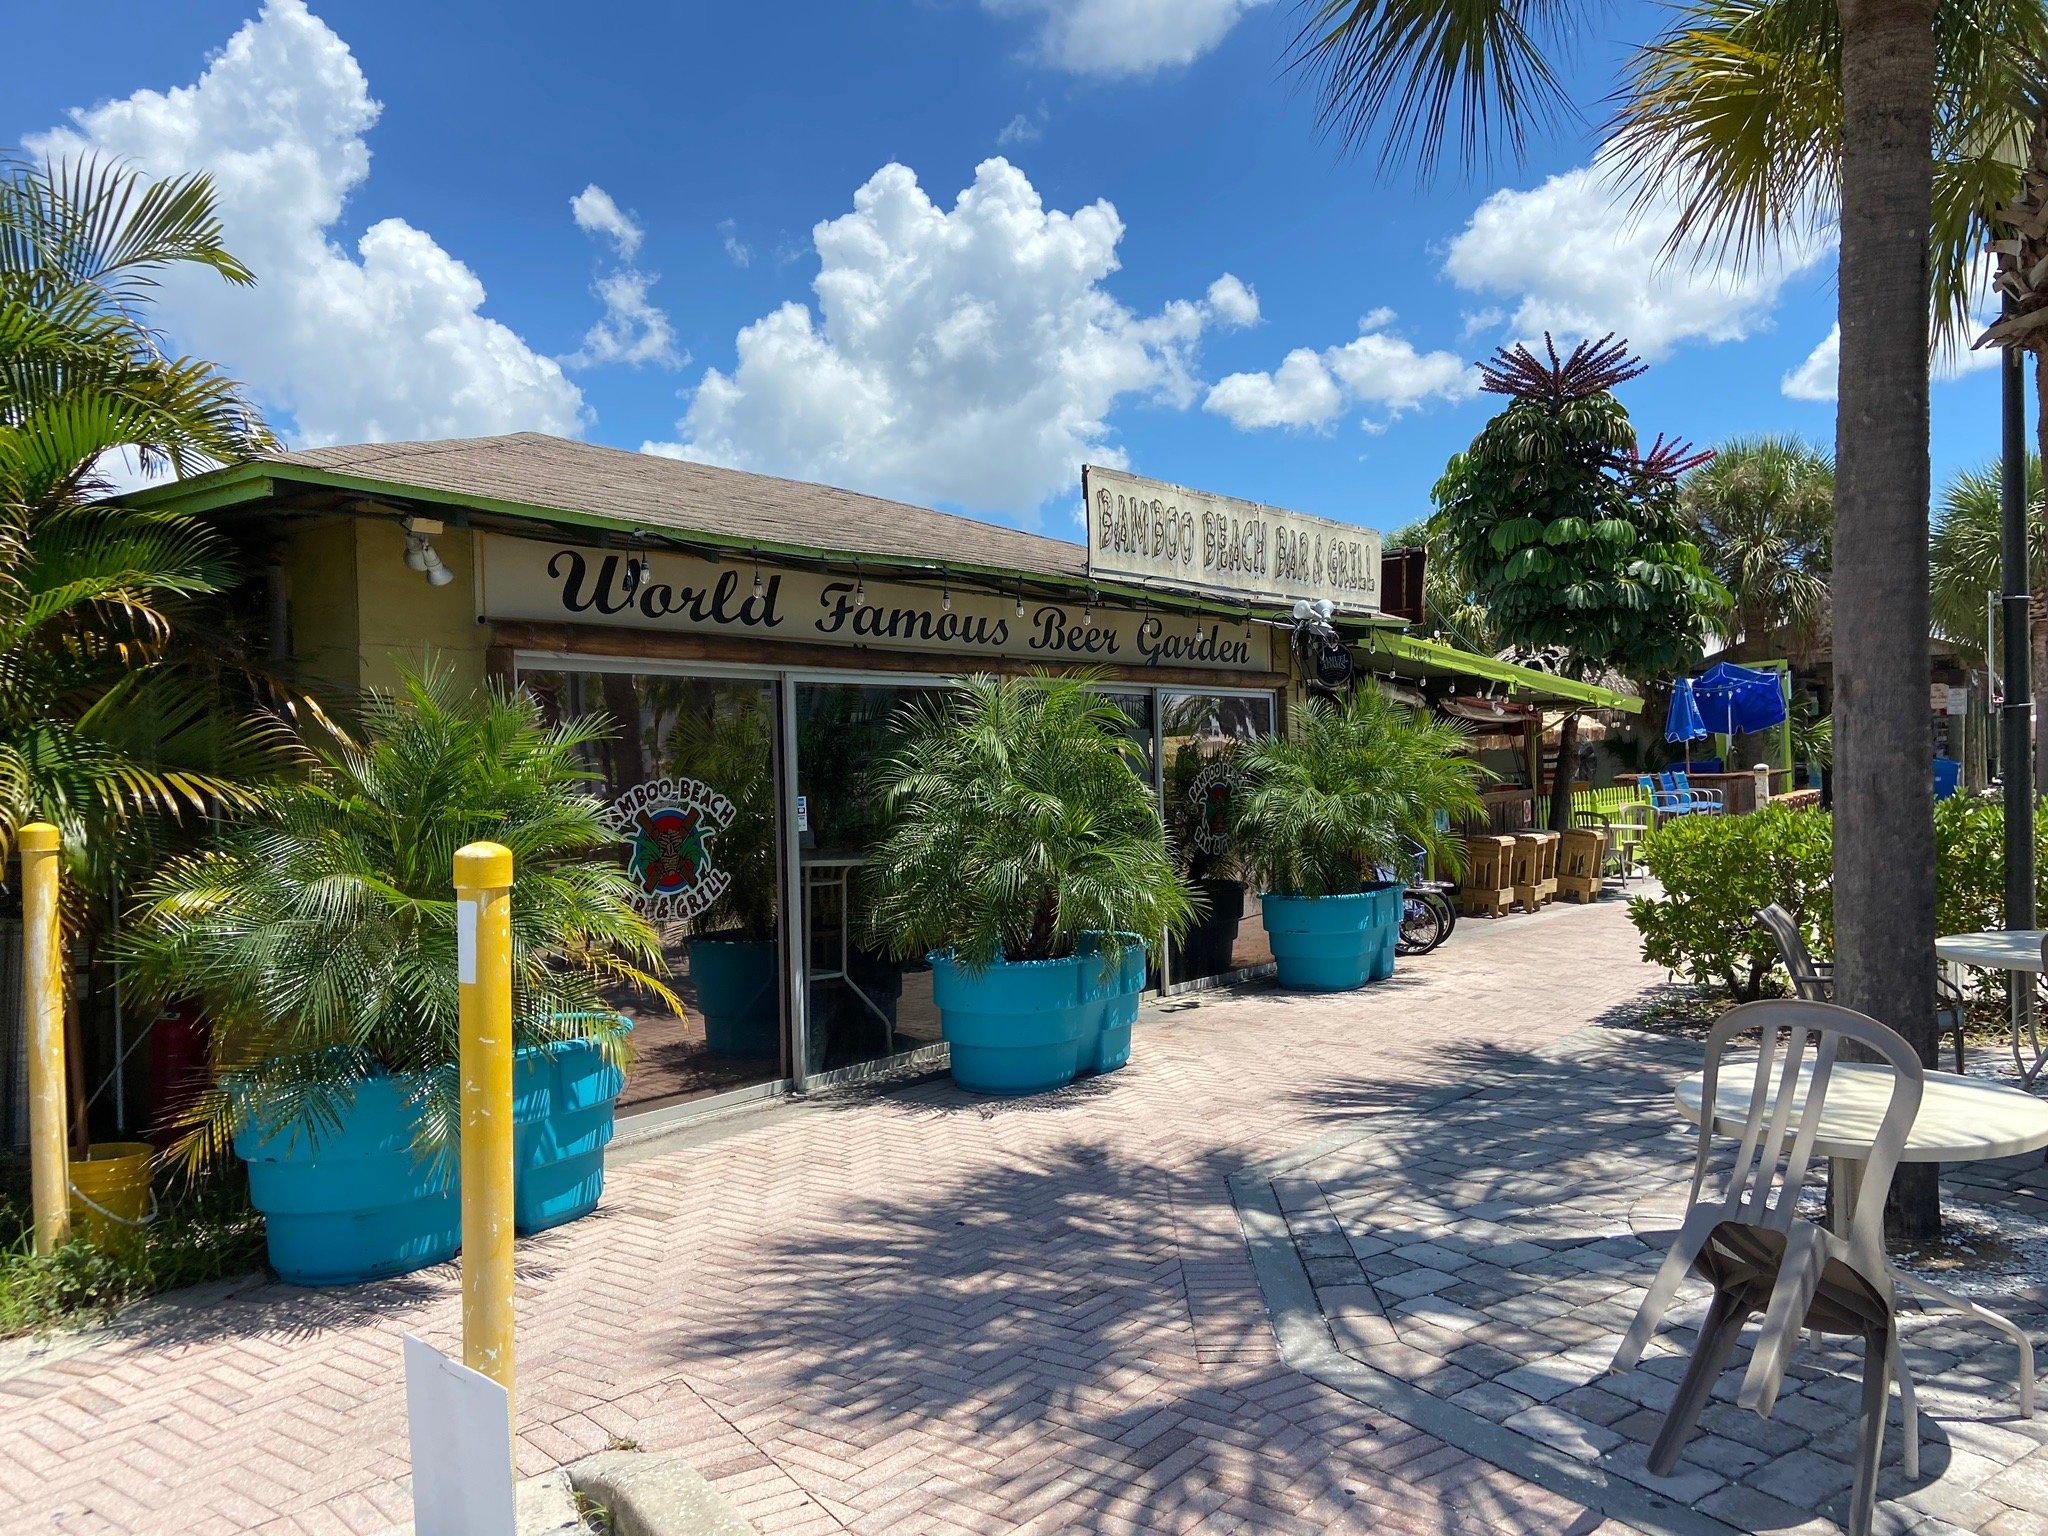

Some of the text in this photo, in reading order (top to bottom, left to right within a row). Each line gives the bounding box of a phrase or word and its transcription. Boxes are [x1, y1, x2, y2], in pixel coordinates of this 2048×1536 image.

[1097, 488, 1376, 592] BAMBOO BEACH BAR & GRILL
[547, 550, 1250, 668] World Famous Beer Garden
[679, 776, 737, 828] BEACH
[655, 892, 671, 921] &
[675, 869, 732, 920] GRILL
